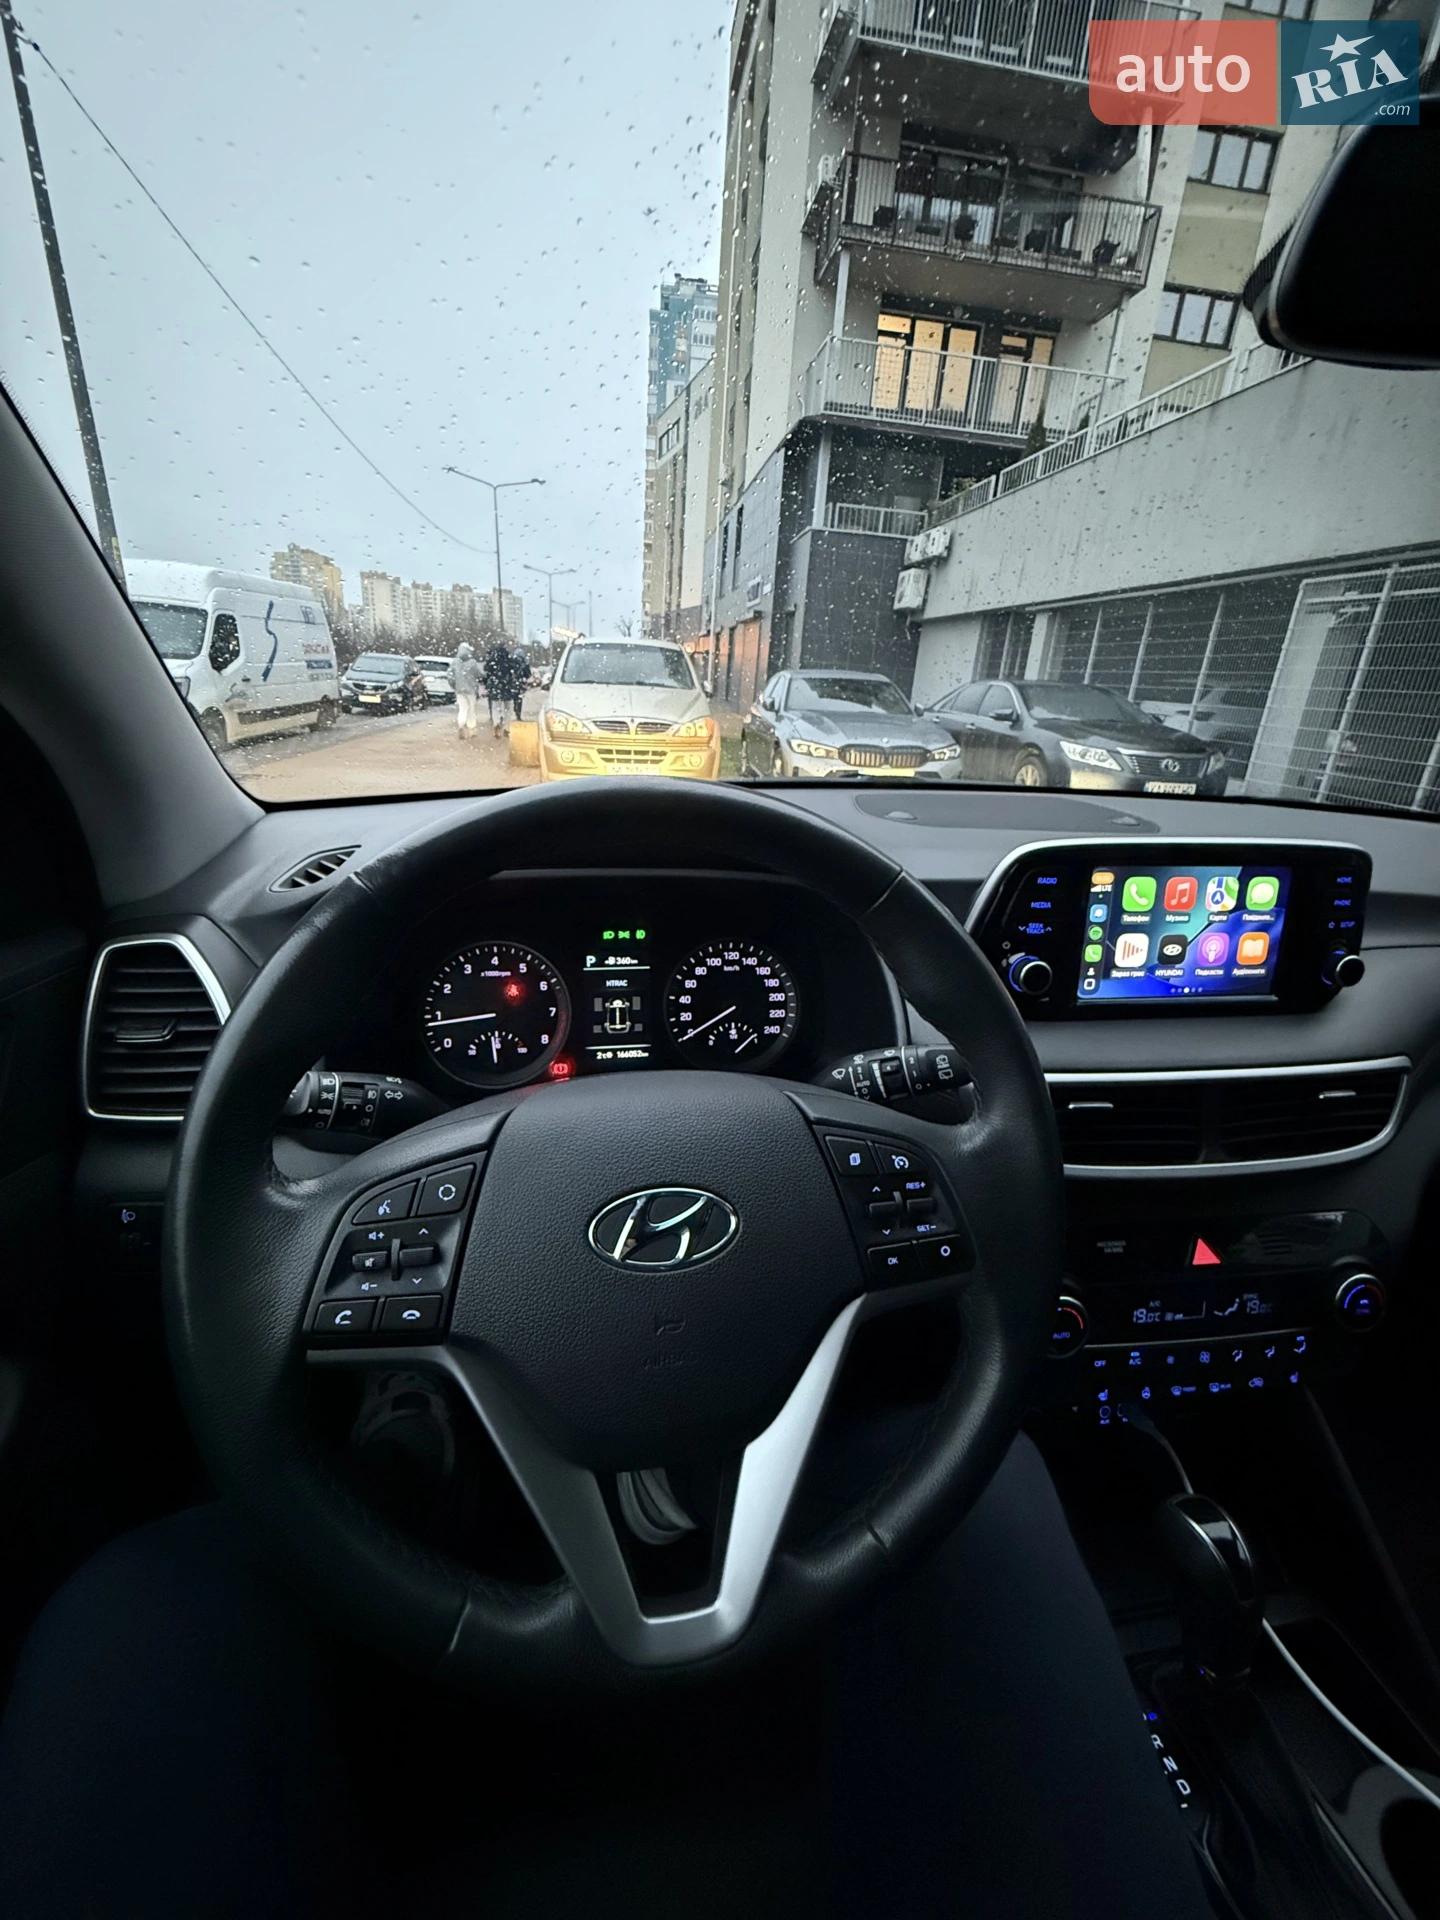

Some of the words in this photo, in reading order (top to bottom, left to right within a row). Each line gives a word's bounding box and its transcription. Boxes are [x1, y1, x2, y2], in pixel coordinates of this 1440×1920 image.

[1037, 877, 1058, 885] RADIO
[724, 952, 740, 960] 120
[491, 956, 499, 965] 4
[586, 955, 596, 968] P
[706, 958, 722, 966] 100
[742, 957, 758, 966] 140
[464, 964, 472, 974] 3
[519, 963, 527, 973] 5
[695, 967, 707, 975] 80
[755, 967, 771, 975] 160
[540, 981, 548, 991] 6
[685, 980, 697, 988] 60
[764, 979, 780, 987] 180
[443, 984, 451, 994] 2
[679, 996, 692, 1004] 40
[769, 993, 785, 1001] 200
[436, 1011, 441, 1020] 1
[549, 1008, 556, 1017] 7
[769, 1010, 786, 1018] 220
[680, 1013, 692, 1021] 20
[764, 1026, 780, 1034] 240
[444, 1038, 452, 1048] 0
[541, 1035, 549, 1044] 8
[888, 1257, 899, 1265] OK
[1053, 1332, 1071, 1340] AUTO
[1151, 1734, 1164, 1750] R
[1163, 1756, 1178, 1772] N
[1176, 1779, 1191, 1795] D
